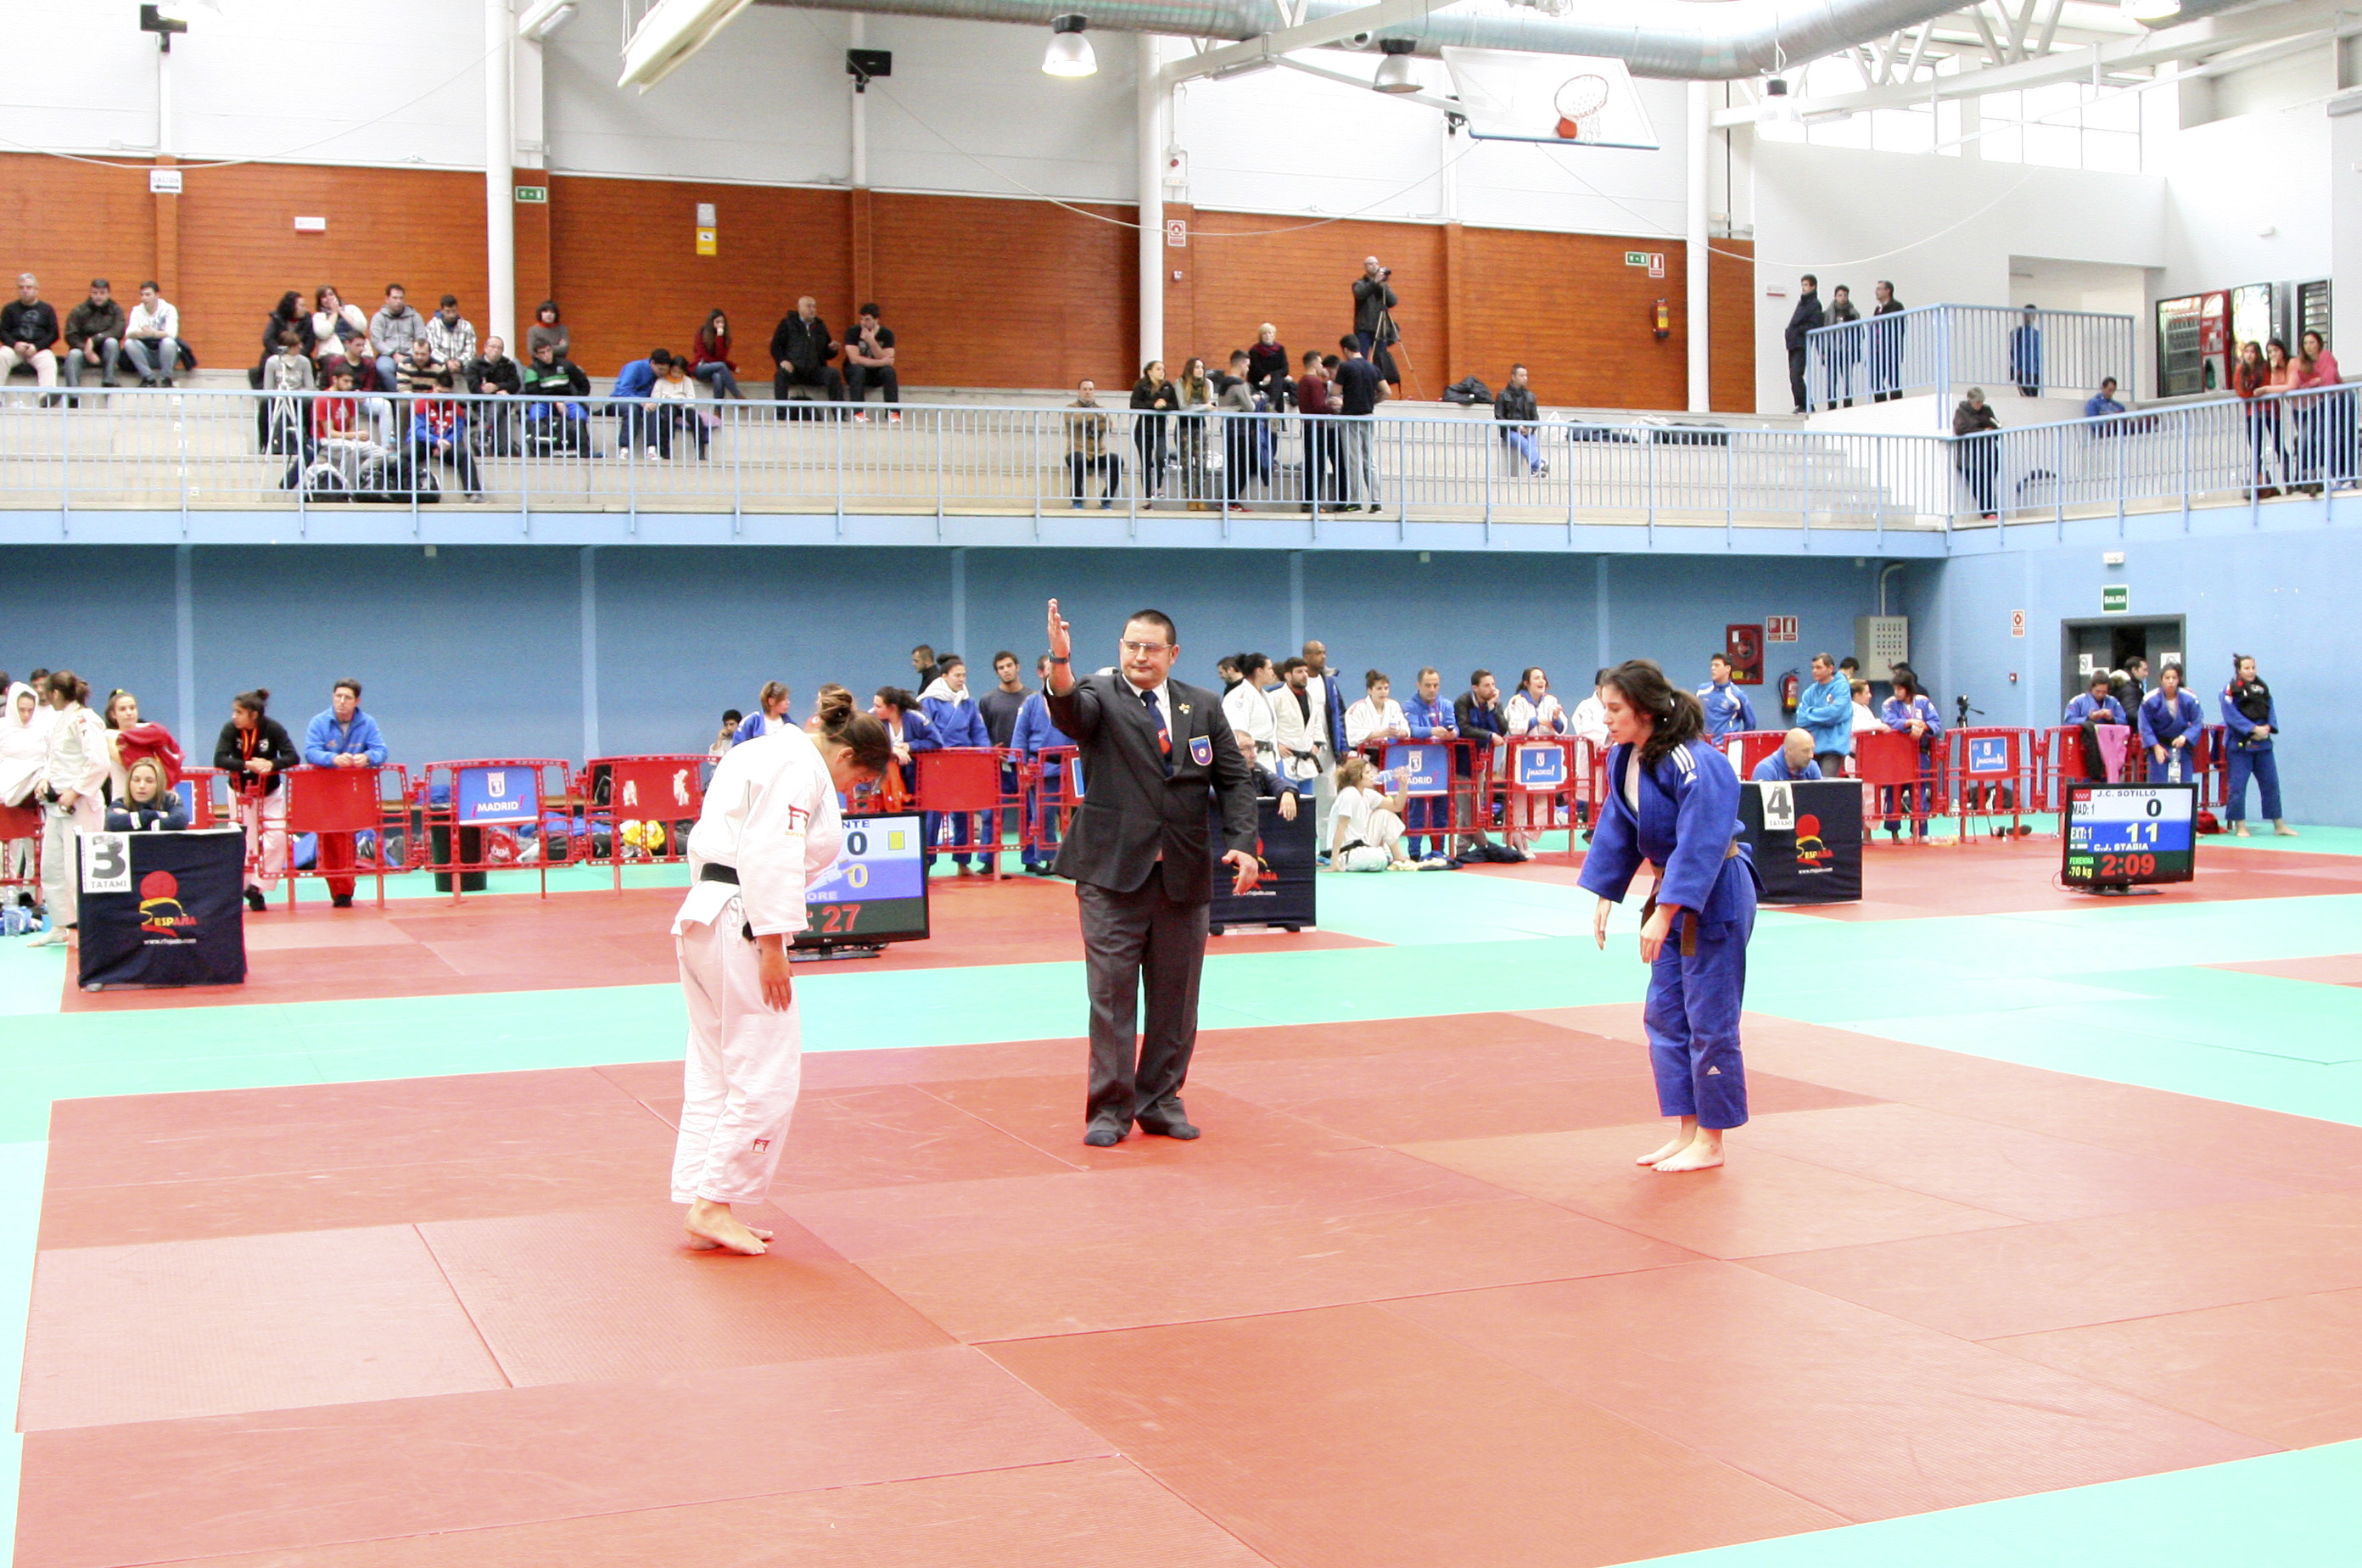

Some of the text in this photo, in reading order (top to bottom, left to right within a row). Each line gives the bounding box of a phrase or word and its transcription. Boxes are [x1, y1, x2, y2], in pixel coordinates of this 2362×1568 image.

[1767, 786, 1792, 820] 4
[2146, 798, 2162, 817] 0
[842, 820, 870, 829] NTE
[847, 832, 868, 855] 0
[92, 835, 126, 879] 3
[2100, 854, 2156, 876] 2:09
[848, 863, 869, 888] 0
[2082, 866, 2093, 878] kg
[91, 880, 127, 889] TATAMI
[806, 891, 838, 901] ORE
[807, 904, 861, 933] :27
